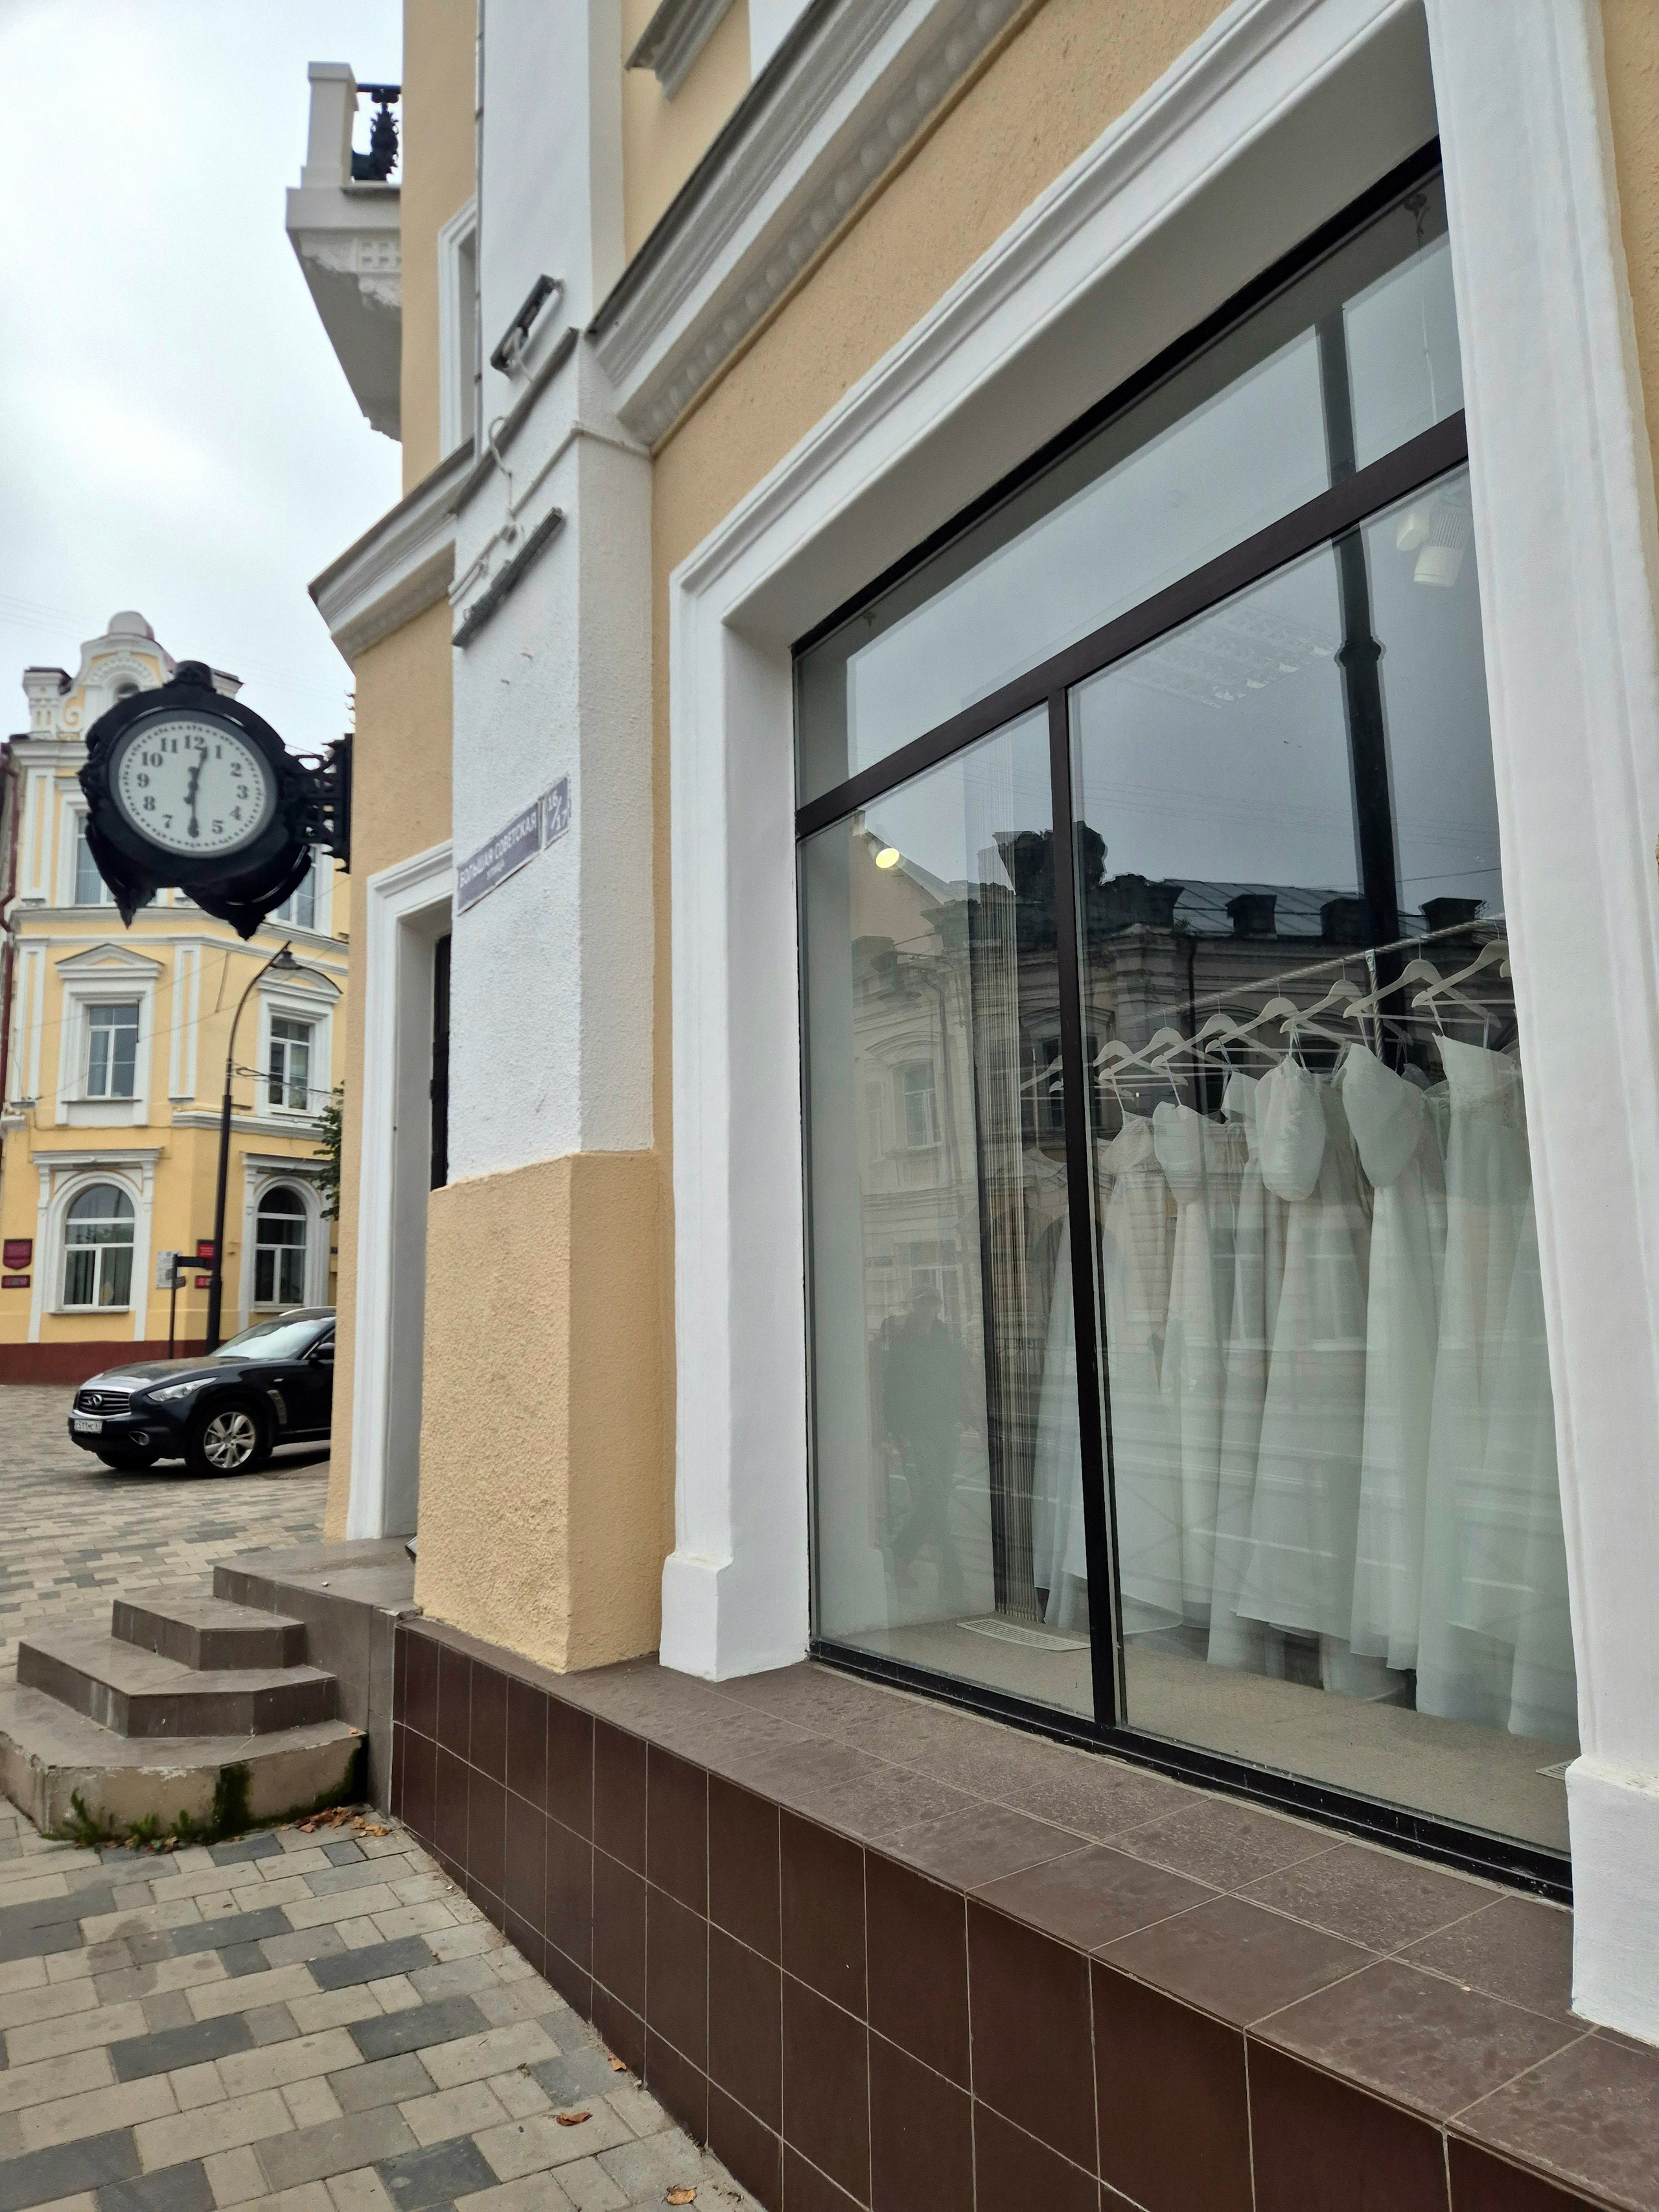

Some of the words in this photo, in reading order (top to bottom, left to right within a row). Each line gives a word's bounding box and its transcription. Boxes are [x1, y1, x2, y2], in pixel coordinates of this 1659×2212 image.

[161, 738, 178, 754] 11
[184, 735, 205, 751] 12
[143, 752, 163, 767] 10
[216, 745, 222, 760] 1
[231, 762, 242, 778] 2
[137, 773, 149, 788] 9
[237, 785, 248, 800] 3
[143, 796, 156, 811] 8
[230, 806, 241, 821] 4
[163, 814, 173, 829] 7
[212, 820, 224, 834] 5
